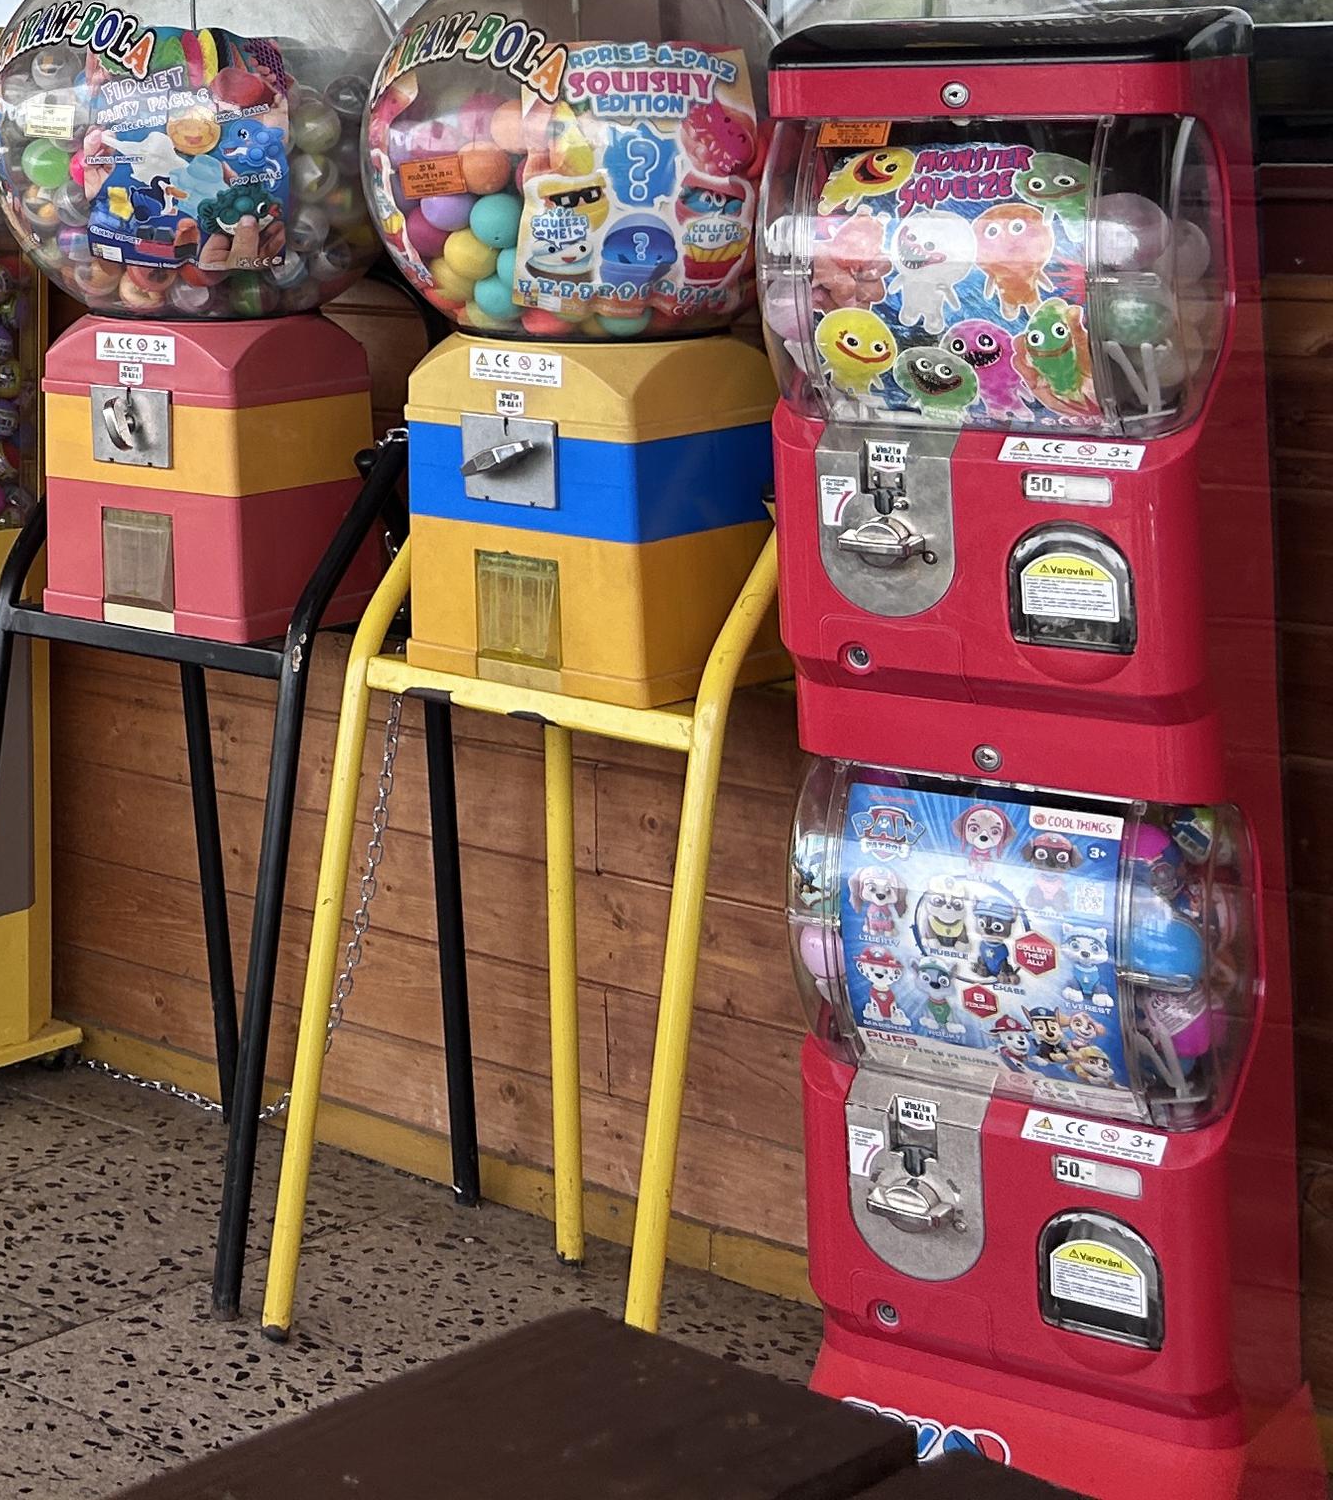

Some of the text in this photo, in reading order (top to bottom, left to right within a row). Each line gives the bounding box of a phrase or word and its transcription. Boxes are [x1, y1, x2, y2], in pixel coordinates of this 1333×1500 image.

[370, 11, 569, 113] ARAM-BOLA
[569, 44, 737, 81] RPRISE-A-PALZ
[100, 66, 184, 105] FIDGET
[566, 70, 715, 99] SQUISHY
[96, 100, 140, 124] PARTY
[148, 90, 196, 112] PACK
[596, 94, 685, 113] EDITION
[915, 144, 1035, 174] MONSTER
[898, 168, 1015, 219] SQUEEZE
[532, 217, 587, 229] SQUEEZE
[546, 227, 574, 240] ME!
[683, 233, 706, 244] ALL
[707, 233, 723, 243] OF
[538, 357, 555, 372] 3+
[1107, 446, 1133, 458] 3+
[1050, 564, 1094, 577] Varování
[851, 810, 927, 846] PAW
[1047, 816, 1113, 834] COOL THINGS
[1089, 847, 1107, 860] 3+
[1016, 943, 1053, 956] COLLECT
[1023, 952, 1048, 962] THEM
[992, 984, 1026, 996] CHASE
[1064, 1000, 1112, 1014] EVEREST
[863, 1018, 914, 1033] MARSHALL
[866, 1030, 918, 1047] PUPS
[1130, 1134, 1156, 1149] 3+
[1079, 1251, 1123, 1270] Varování
